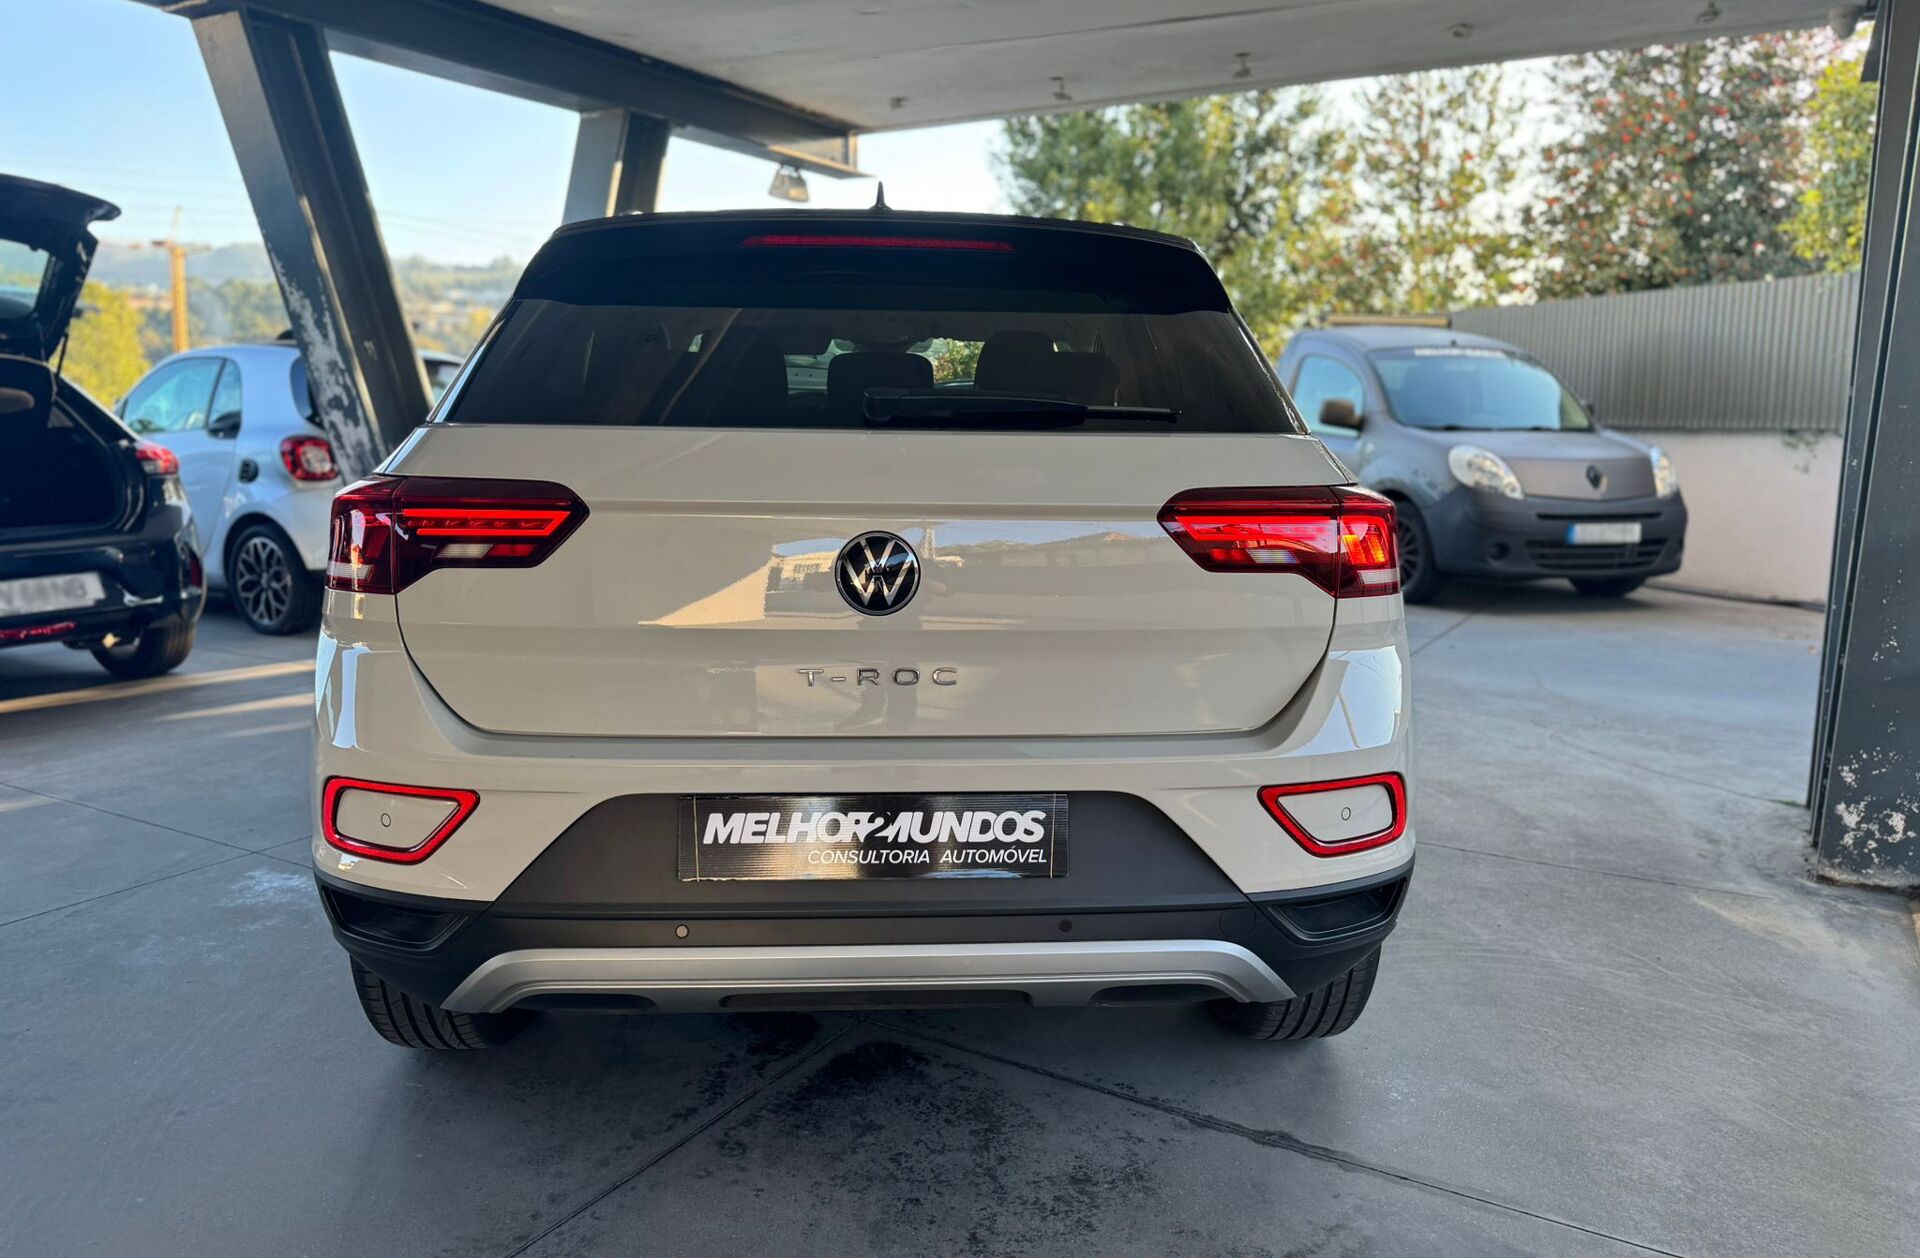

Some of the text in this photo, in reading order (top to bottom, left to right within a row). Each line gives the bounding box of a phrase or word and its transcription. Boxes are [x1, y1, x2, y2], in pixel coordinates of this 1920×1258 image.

[797, 666, 958, 687] T-ROC
[807, 845, 1048, 864] CONSULTORIA AUTOMÓVEL
